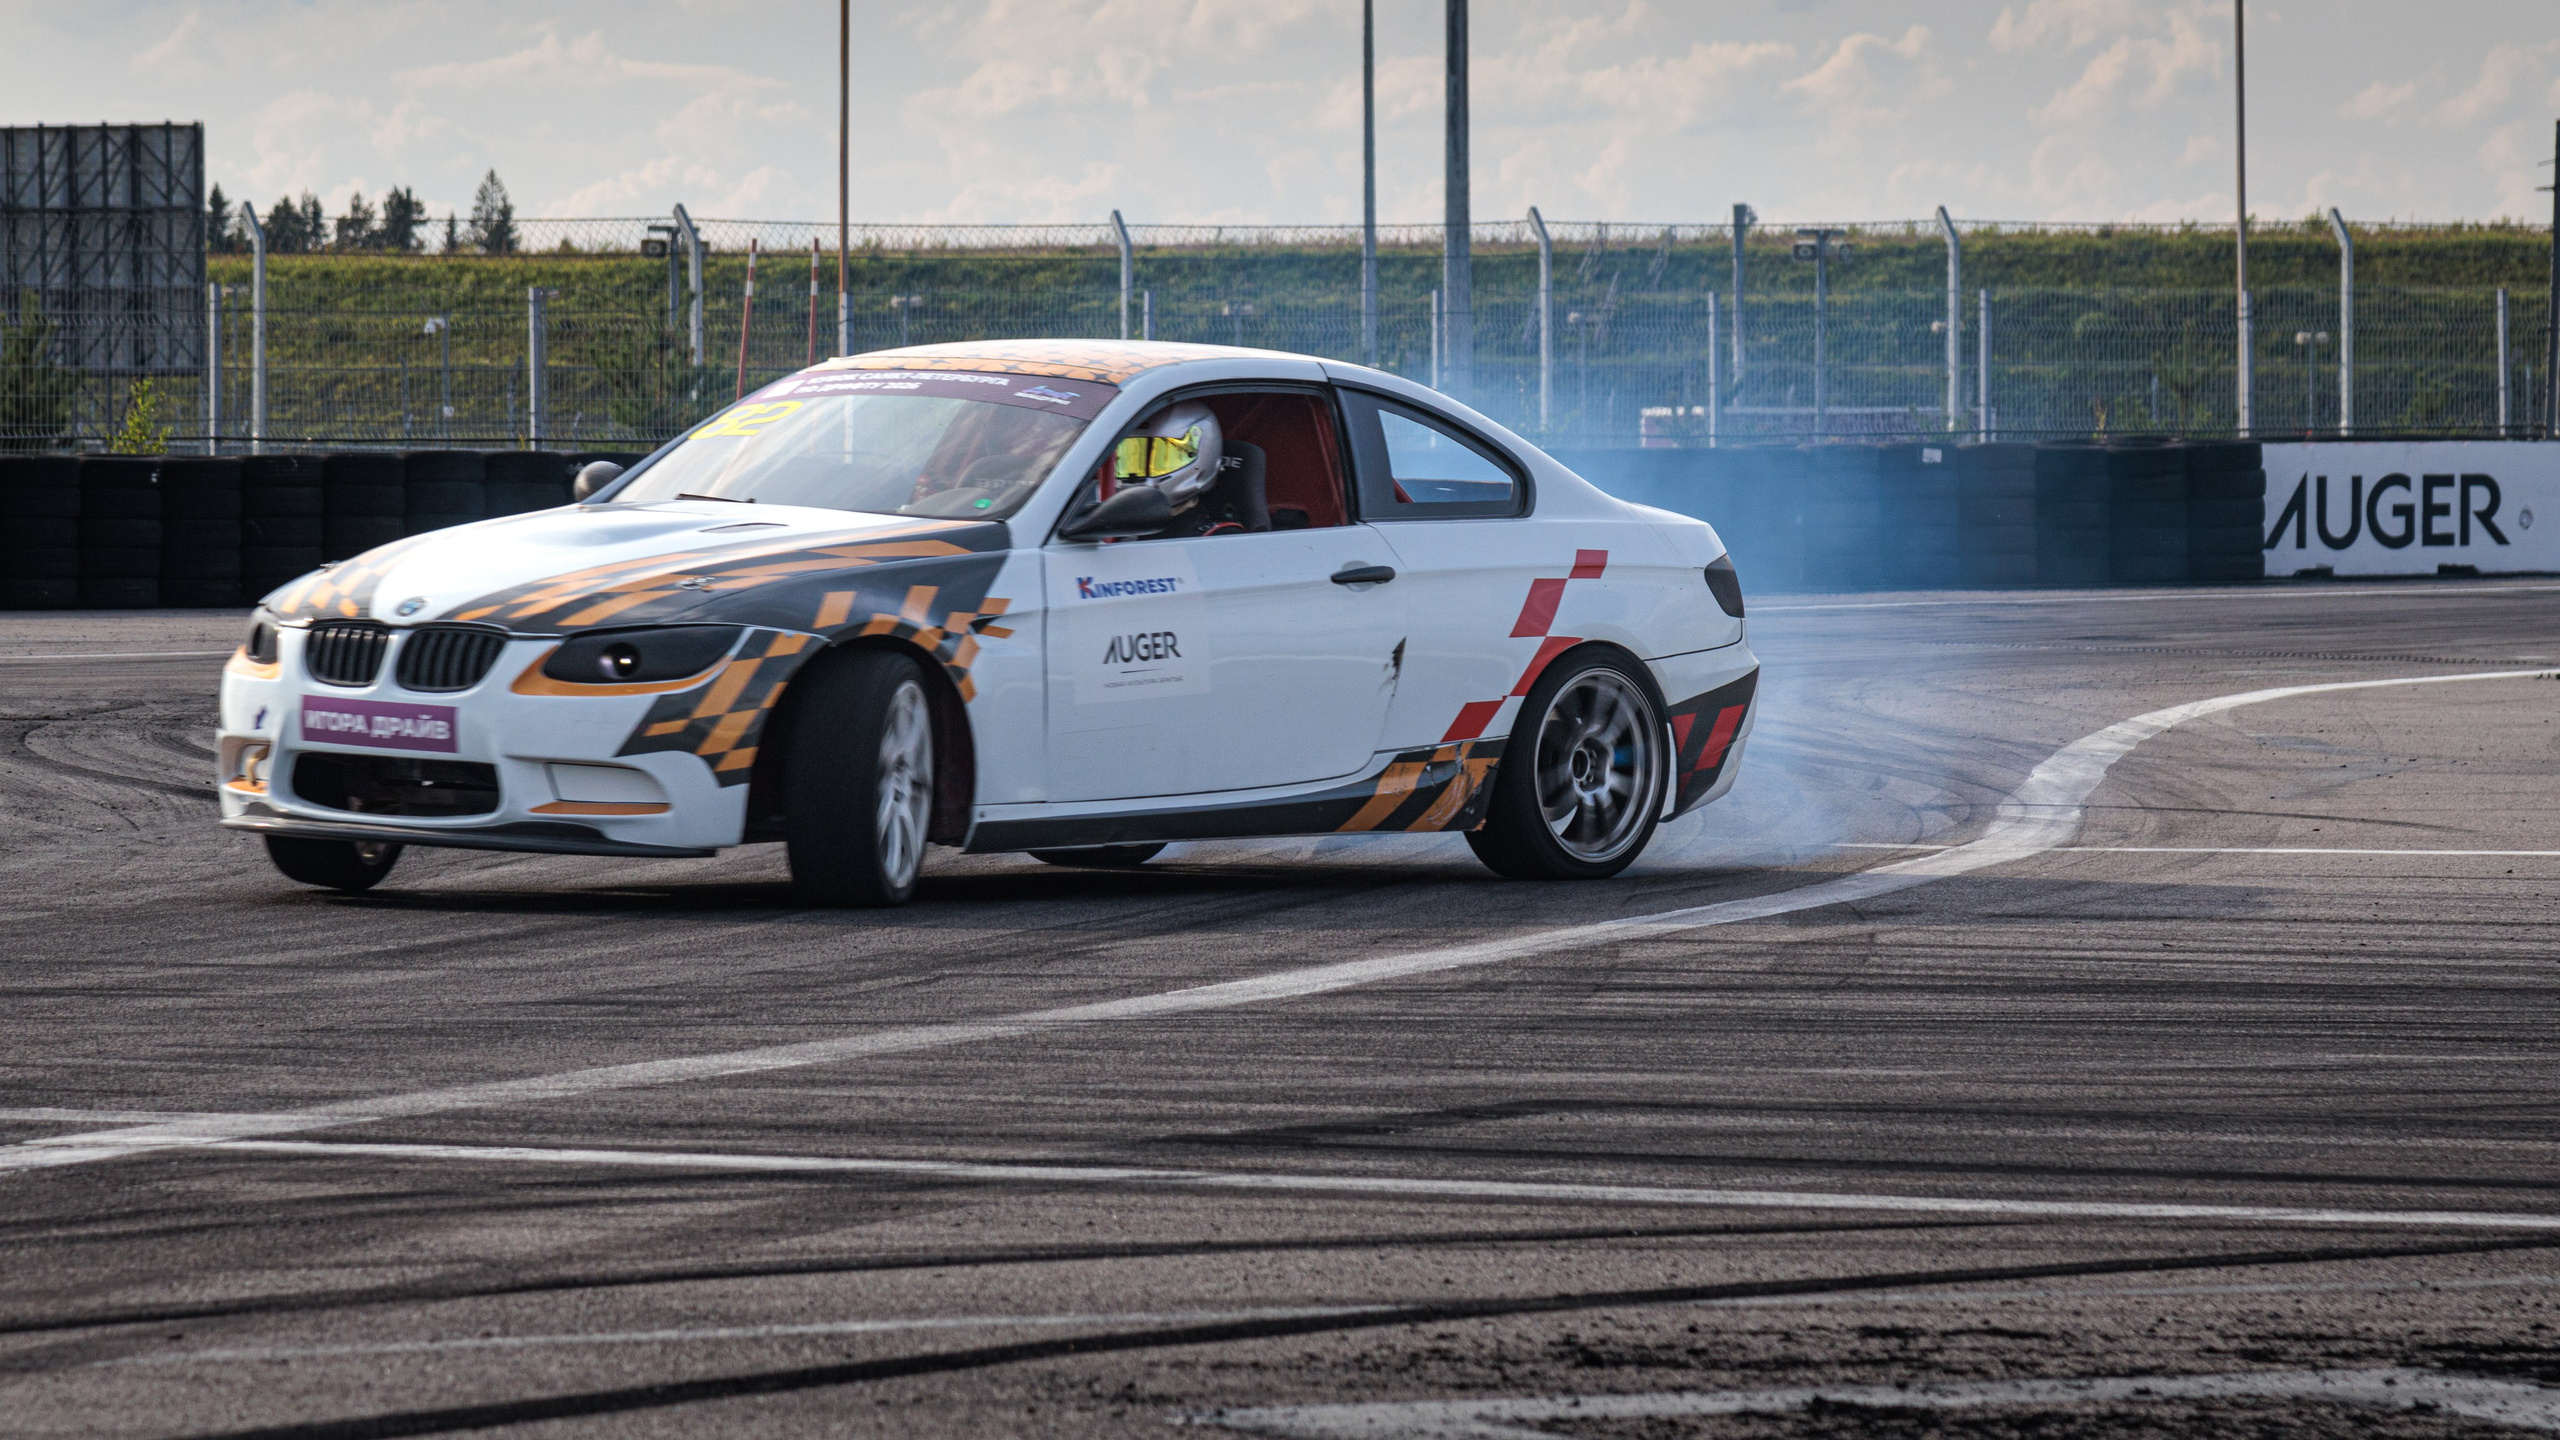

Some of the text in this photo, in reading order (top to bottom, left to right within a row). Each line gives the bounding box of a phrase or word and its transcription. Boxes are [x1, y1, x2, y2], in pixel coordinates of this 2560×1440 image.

[688, 400, 804, 441] 82
[2264, 471, 2511, 550] AUGER
[1076, 576, 1176, 599] KINFOREST
[1102, 631, 1182, 664] AUGER
[304, 709, 450, 740] ИГОРА ДРАЙВ
